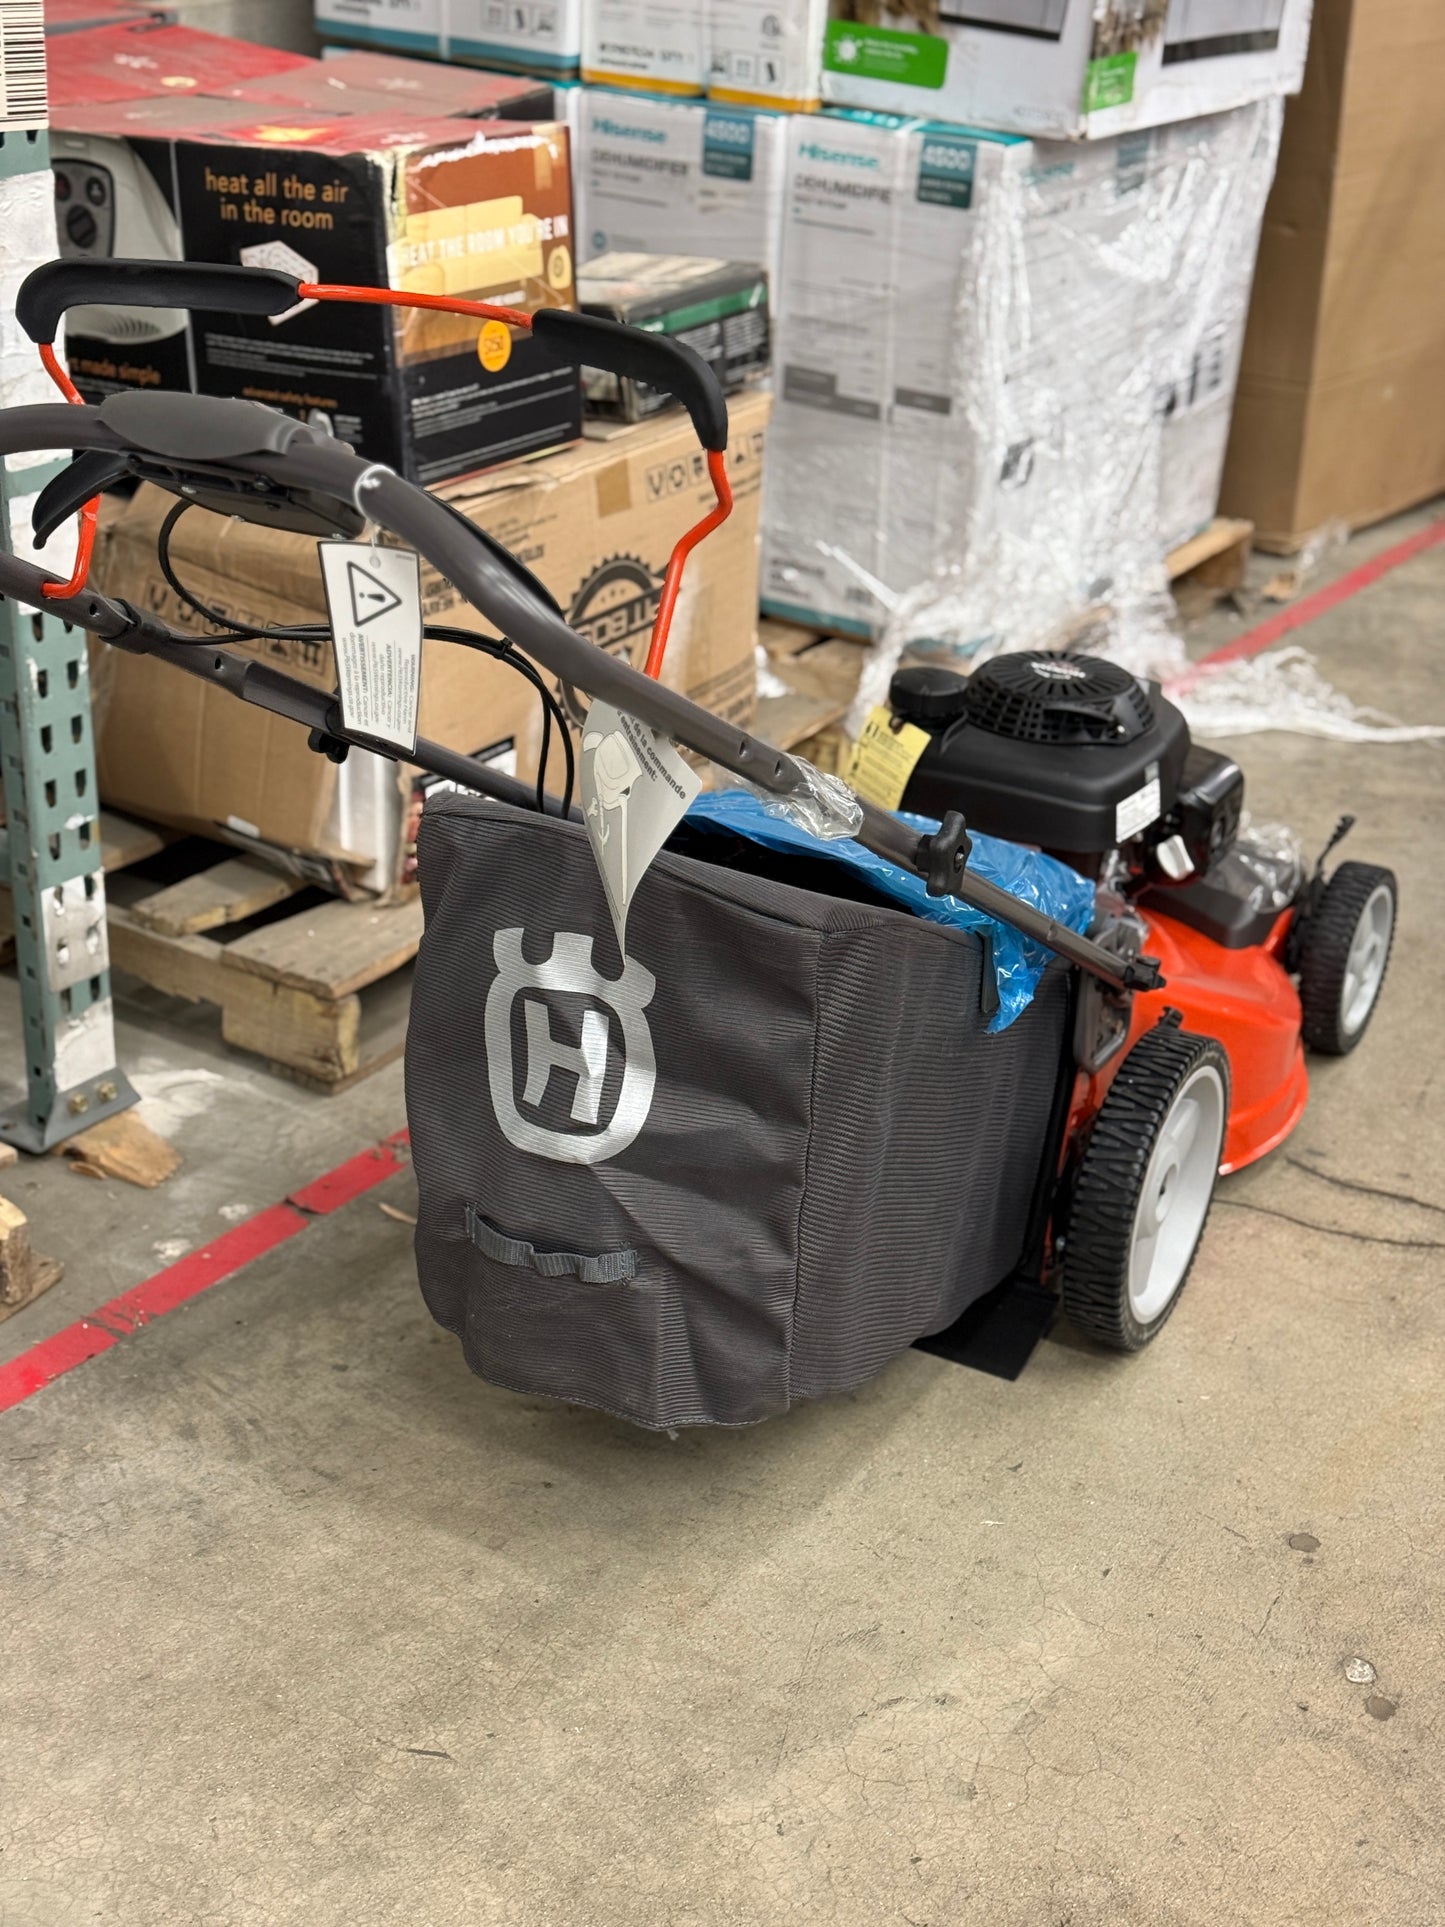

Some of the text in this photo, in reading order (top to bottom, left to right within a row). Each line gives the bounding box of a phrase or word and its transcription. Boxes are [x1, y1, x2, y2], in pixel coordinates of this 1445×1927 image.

[591, 117, 668, 144] Hisense
[799, 142, 880, 171] Hisense
[205, 166, 349, 203] heat all the air
[220, 197, 333, 230] in the room
[633, 722, 642, 737] de
[640, 734, 648, 748] la
[646, 747, 686, 799] commande
